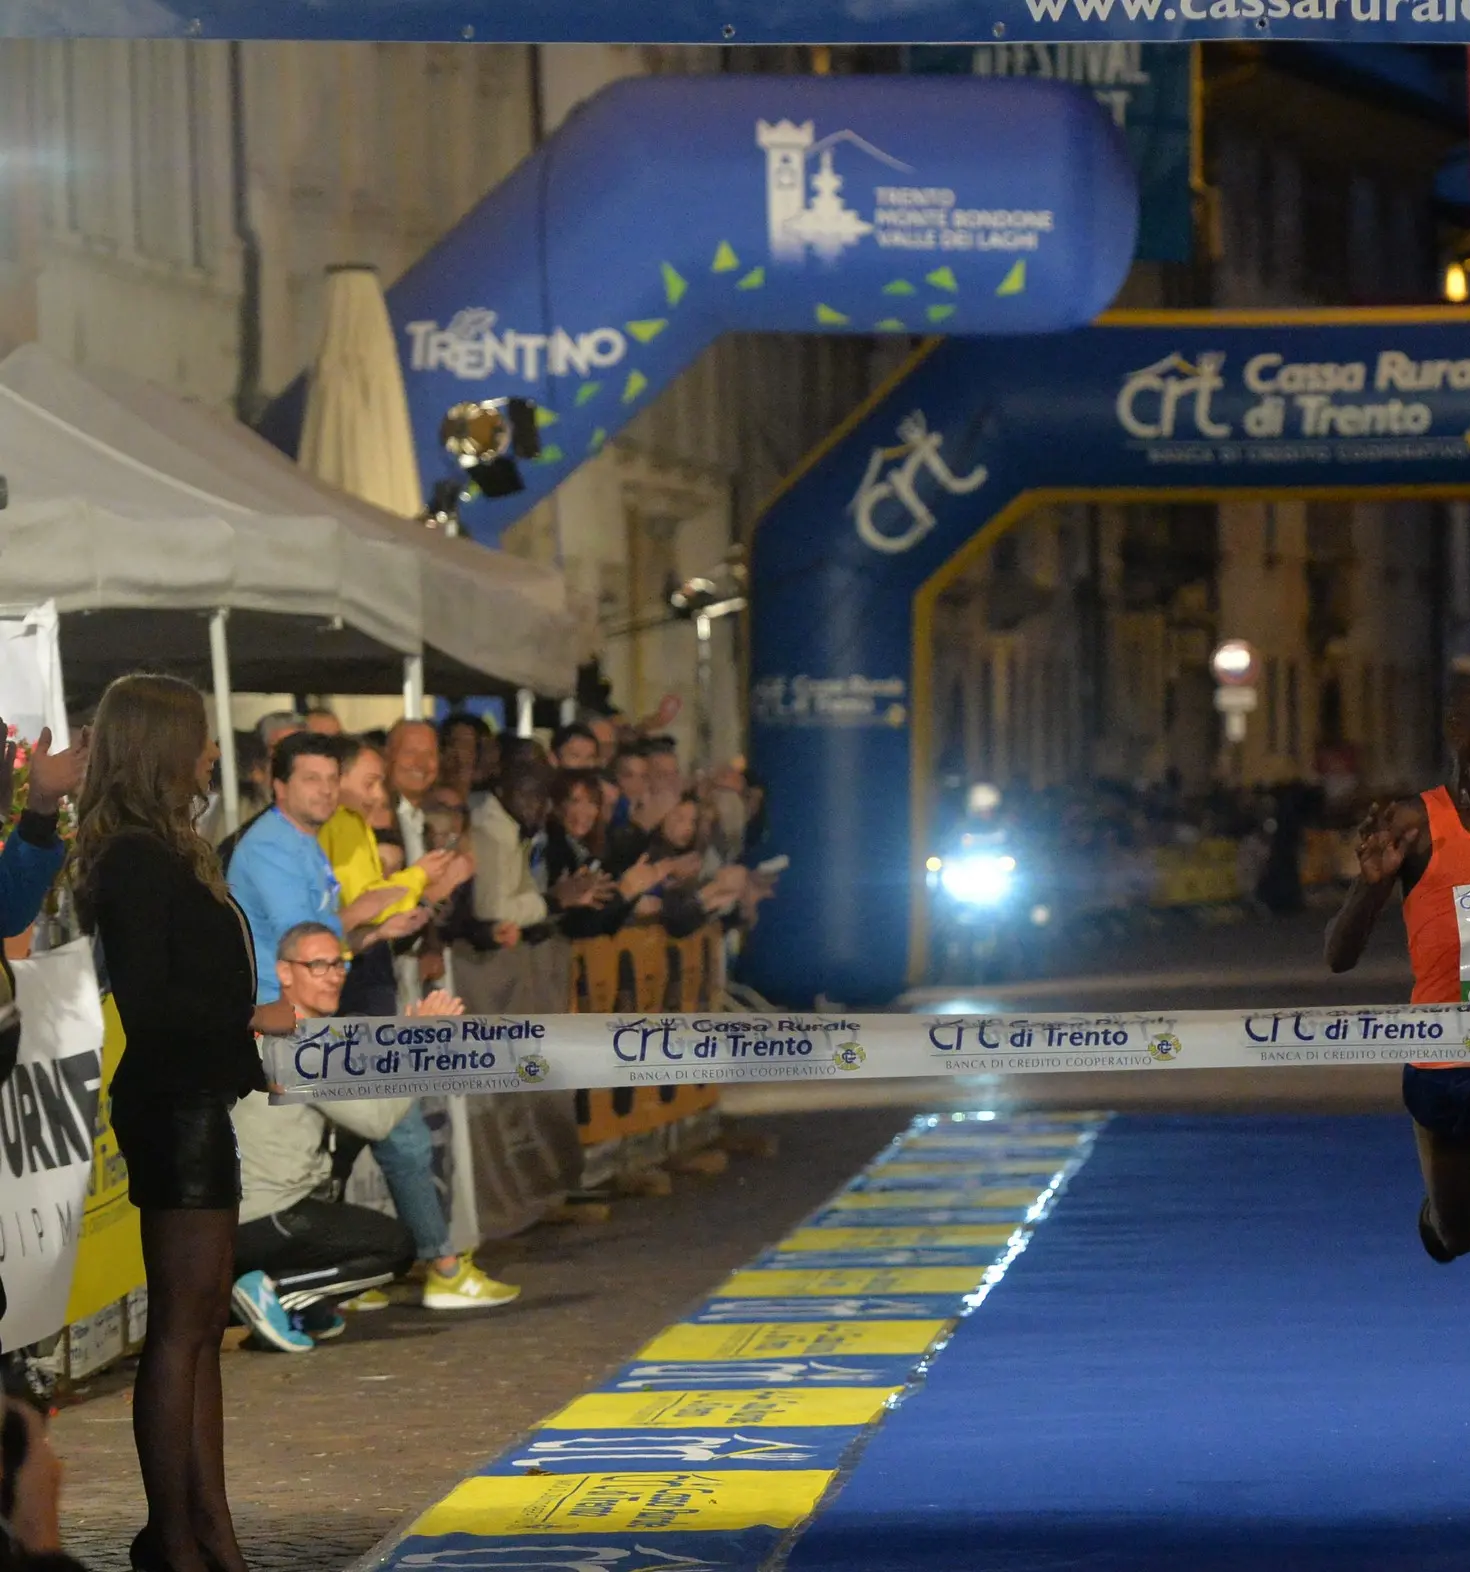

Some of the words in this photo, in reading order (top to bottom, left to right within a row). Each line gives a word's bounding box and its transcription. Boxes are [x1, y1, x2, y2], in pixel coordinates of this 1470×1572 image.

[405, 316, 628, 382] TRENTINO
[1243, 353, 1365, 393] Cassa
[1242, 396, 1285, 438] di
[1297, 396, 1432, 437] Trento
[375, 1023, 452, 1047] Cassa
[461, 1020, 546, 1042] Rurale
[692, 1018, 769, 1034] Cassa
[777, 1018, 862, 1033] Rurale
[1009, 1028, 1033, 1048] di
[1043, 1027, 1129, 1048] Trento
[1325, 1018, 1349, 1041] di
[1358, 1016, 1445, 1040] Trento
[694, 1035, 717, 1059] di
[727, 1034, 813, 1058] Trento
[1260, 1050, 1301, 1062] BANCA
[1306, 1050, 1320, 1061] DI
[1323, 1049, 1377, 1061] CREDITO
[1380, 1048, 1468, 1061] COOPERATIVO
[376, 1050, 399, 1074] di
[408, 1048, 496, 1073] Trento
[629, 1070, 671, 1082] BANCA
[675, 1069, 690, 1081] DI
[692, 1067, 746, 1080] CREDITO
[750, 1064, 837, 1078] COOPERATIVO
[945, 1058, 987, 1070] BANCA
[990, 1057, 1005, 1069] DI
[1008, 1055, 1062, 1069] CREDITO
[1066, 1054, 1153, 1068] COOPERATIVO
